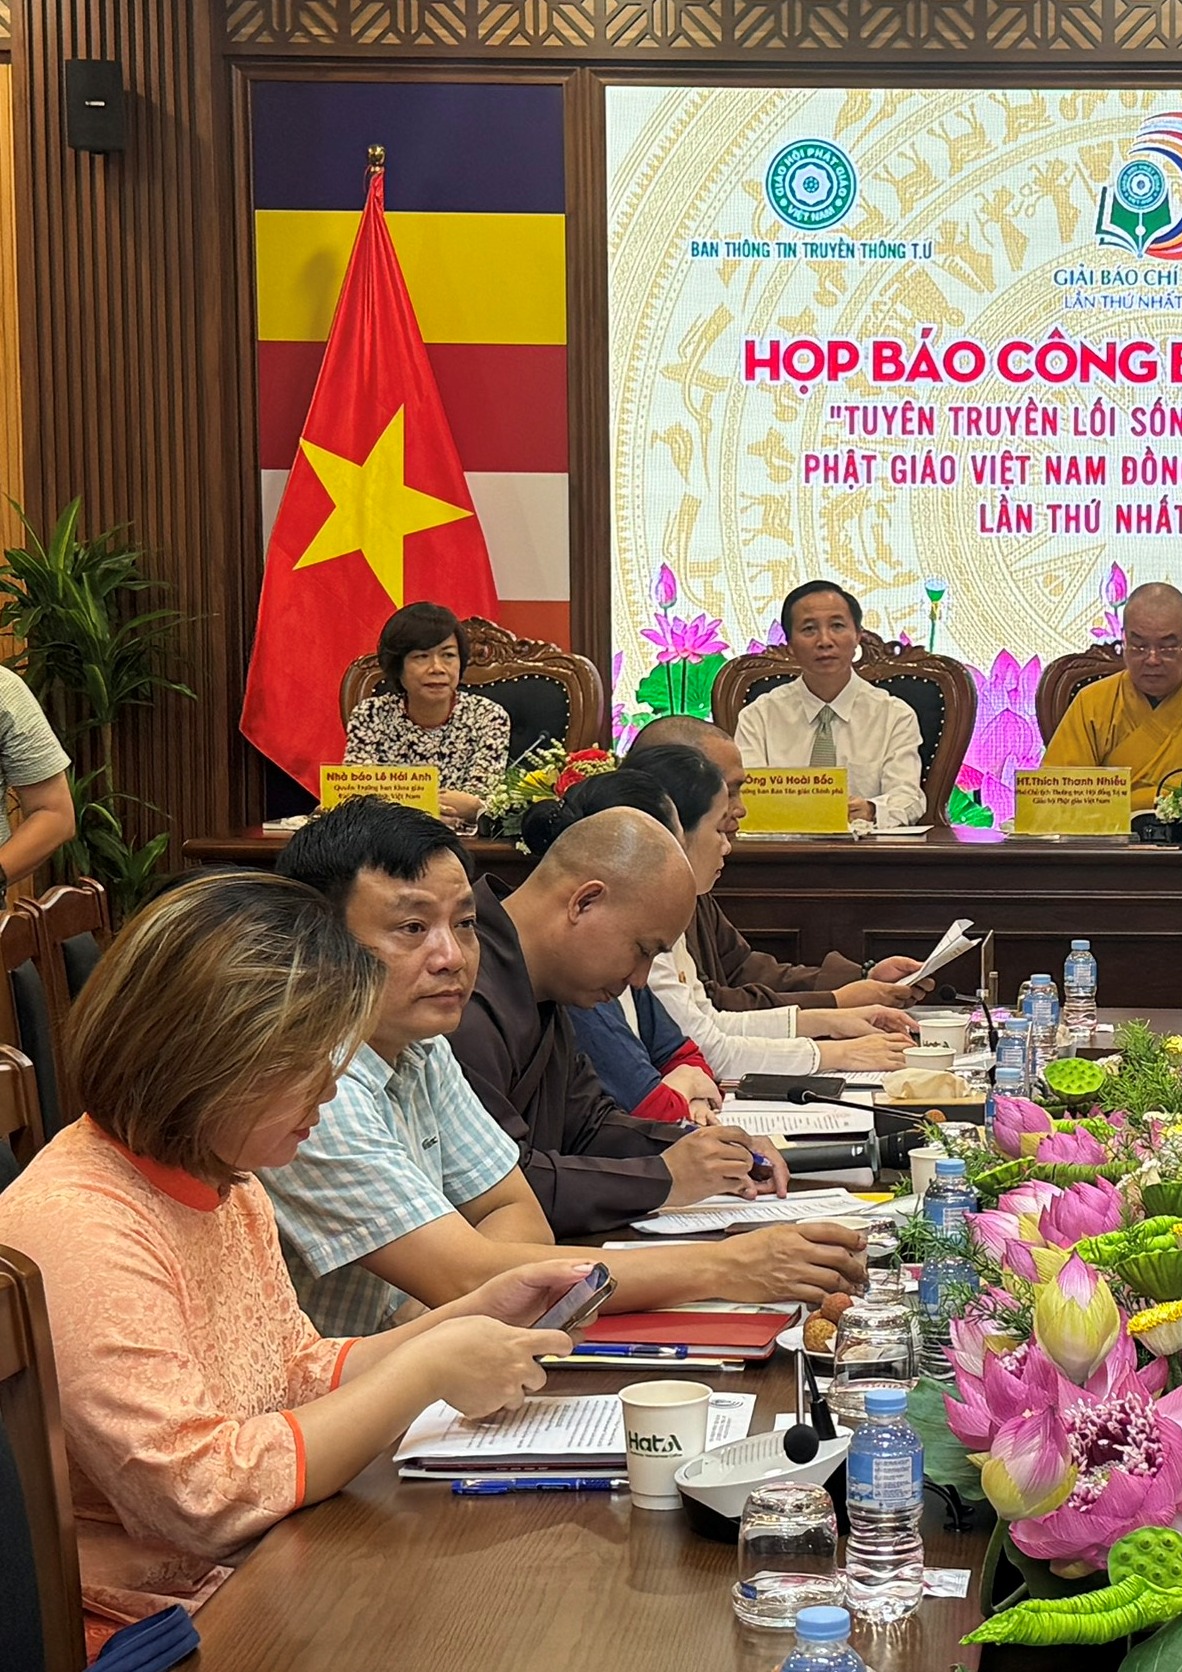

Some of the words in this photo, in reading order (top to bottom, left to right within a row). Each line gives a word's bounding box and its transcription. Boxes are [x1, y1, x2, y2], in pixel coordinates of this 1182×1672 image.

[691, 241, 719, 257] BAN
[725, 238, 770, 258] THÔNG
[775, 241, 797, 258] TIN
[801, 237, 855, 258] TRUYỀN
[860, 239, 906, 258] THÔNG
[1053, 263, 1094, 286] GIẢI
[1101, 265, 1138, 286] BÁO
[1143, 264, 1179, 286] CHÍ
[1064, 289, 1096, 309] LẦN
[1100, 291, 1134, 309] THỨ
[744, 340, 860, 394] HỌP
[872, 328, 987, 382] BÁO
[1001, 327, 1158, 383] CÔNG
[829, 400, 935, 437] "TUYÊN
[948, 396, 1059, 437] TRUYỀN
[1073, 396, 1116, 437] LỐI
[804, 449, 878, 490] PHẬT
[890, 449, 956, 485] GIÁO
[969, 449, 1032, 490] VIỆT
[1045, 454, 1106, 485] NAM
[979, 494, 1033, 533] LẦN
[1046, 496, 1102, 533] THỨ
[326, 772, 348, 781] Nhà
[351, 772, 372, 781] báo
[411, 772, 431, 781] Anh
[745, 773, 766, 786] Ông
[1062, 775, 1093, 786] Thanh
